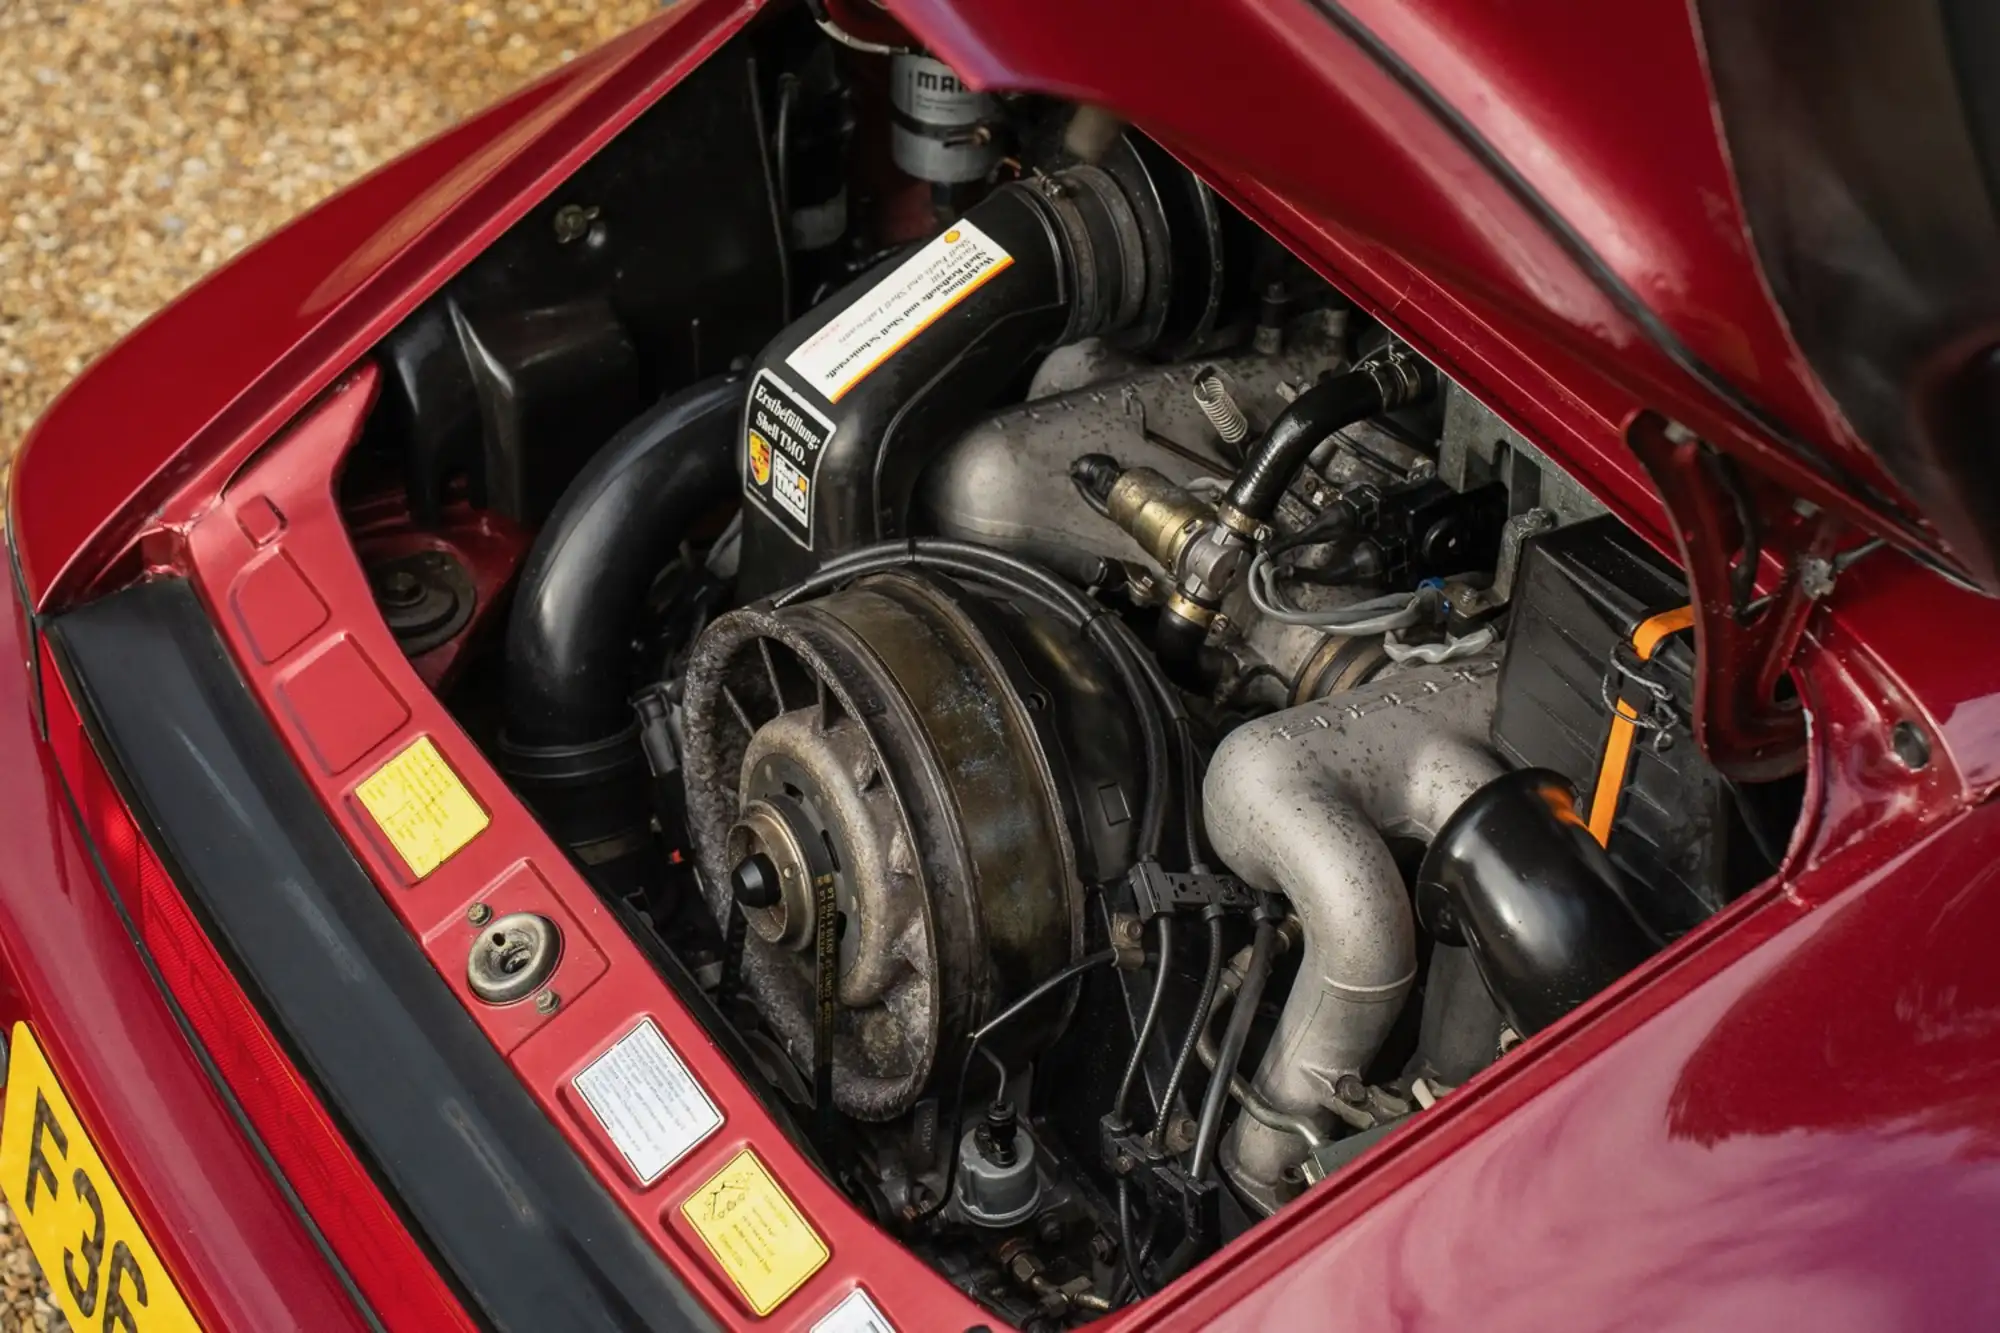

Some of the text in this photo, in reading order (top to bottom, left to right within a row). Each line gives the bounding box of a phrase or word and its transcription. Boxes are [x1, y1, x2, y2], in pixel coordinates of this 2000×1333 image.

[963, 249, 987, 271] Shell
[903, 302, 920, 318] und
[881, 315, 905, 336] Shell
[755, 383, 821, 450] Erstbefüllung:
[756, 410, 806, 466] Shell TMO.
[776, 474, 806, 511] TMO
